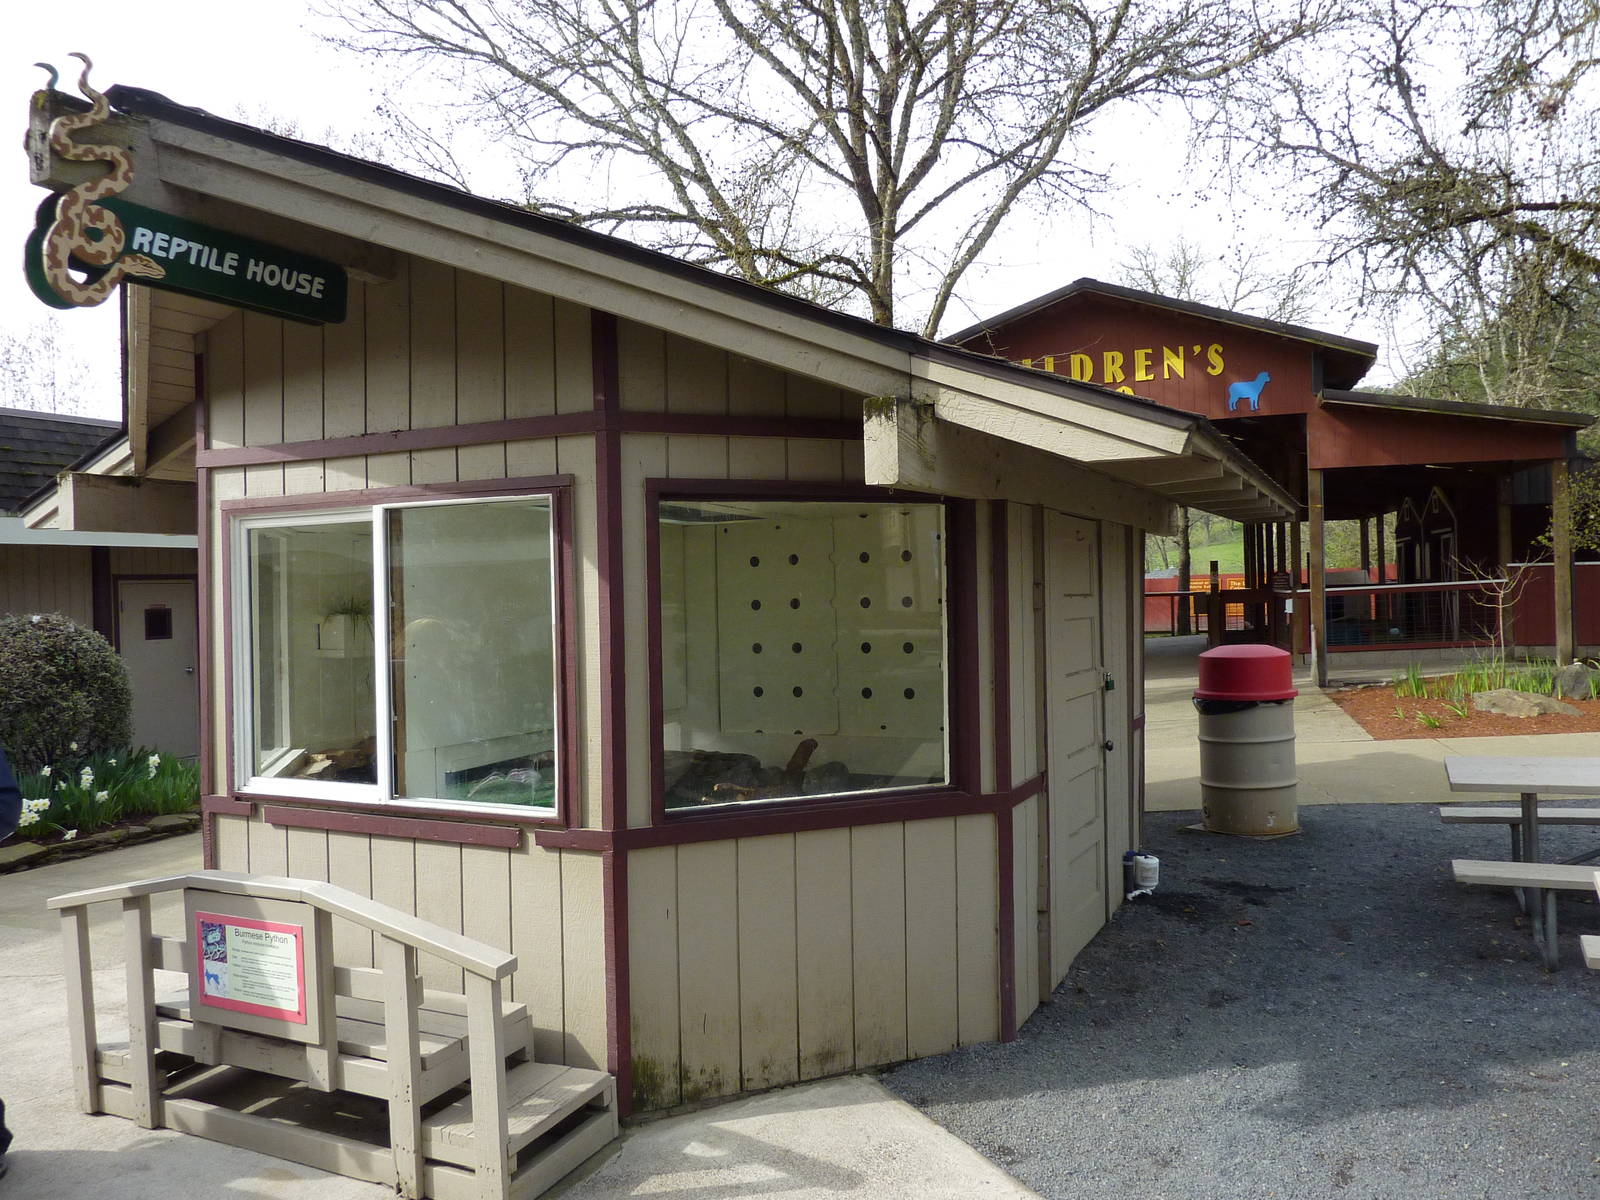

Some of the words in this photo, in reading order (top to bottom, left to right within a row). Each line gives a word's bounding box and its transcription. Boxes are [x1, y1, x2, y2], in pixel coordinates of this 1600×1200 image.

[133, 227, 239, 275] REPTILE
[247, 259, 326, 298] HOUSE
[234, 928, 263, 940] Burmese
[265, 933, 288, 944] Python
